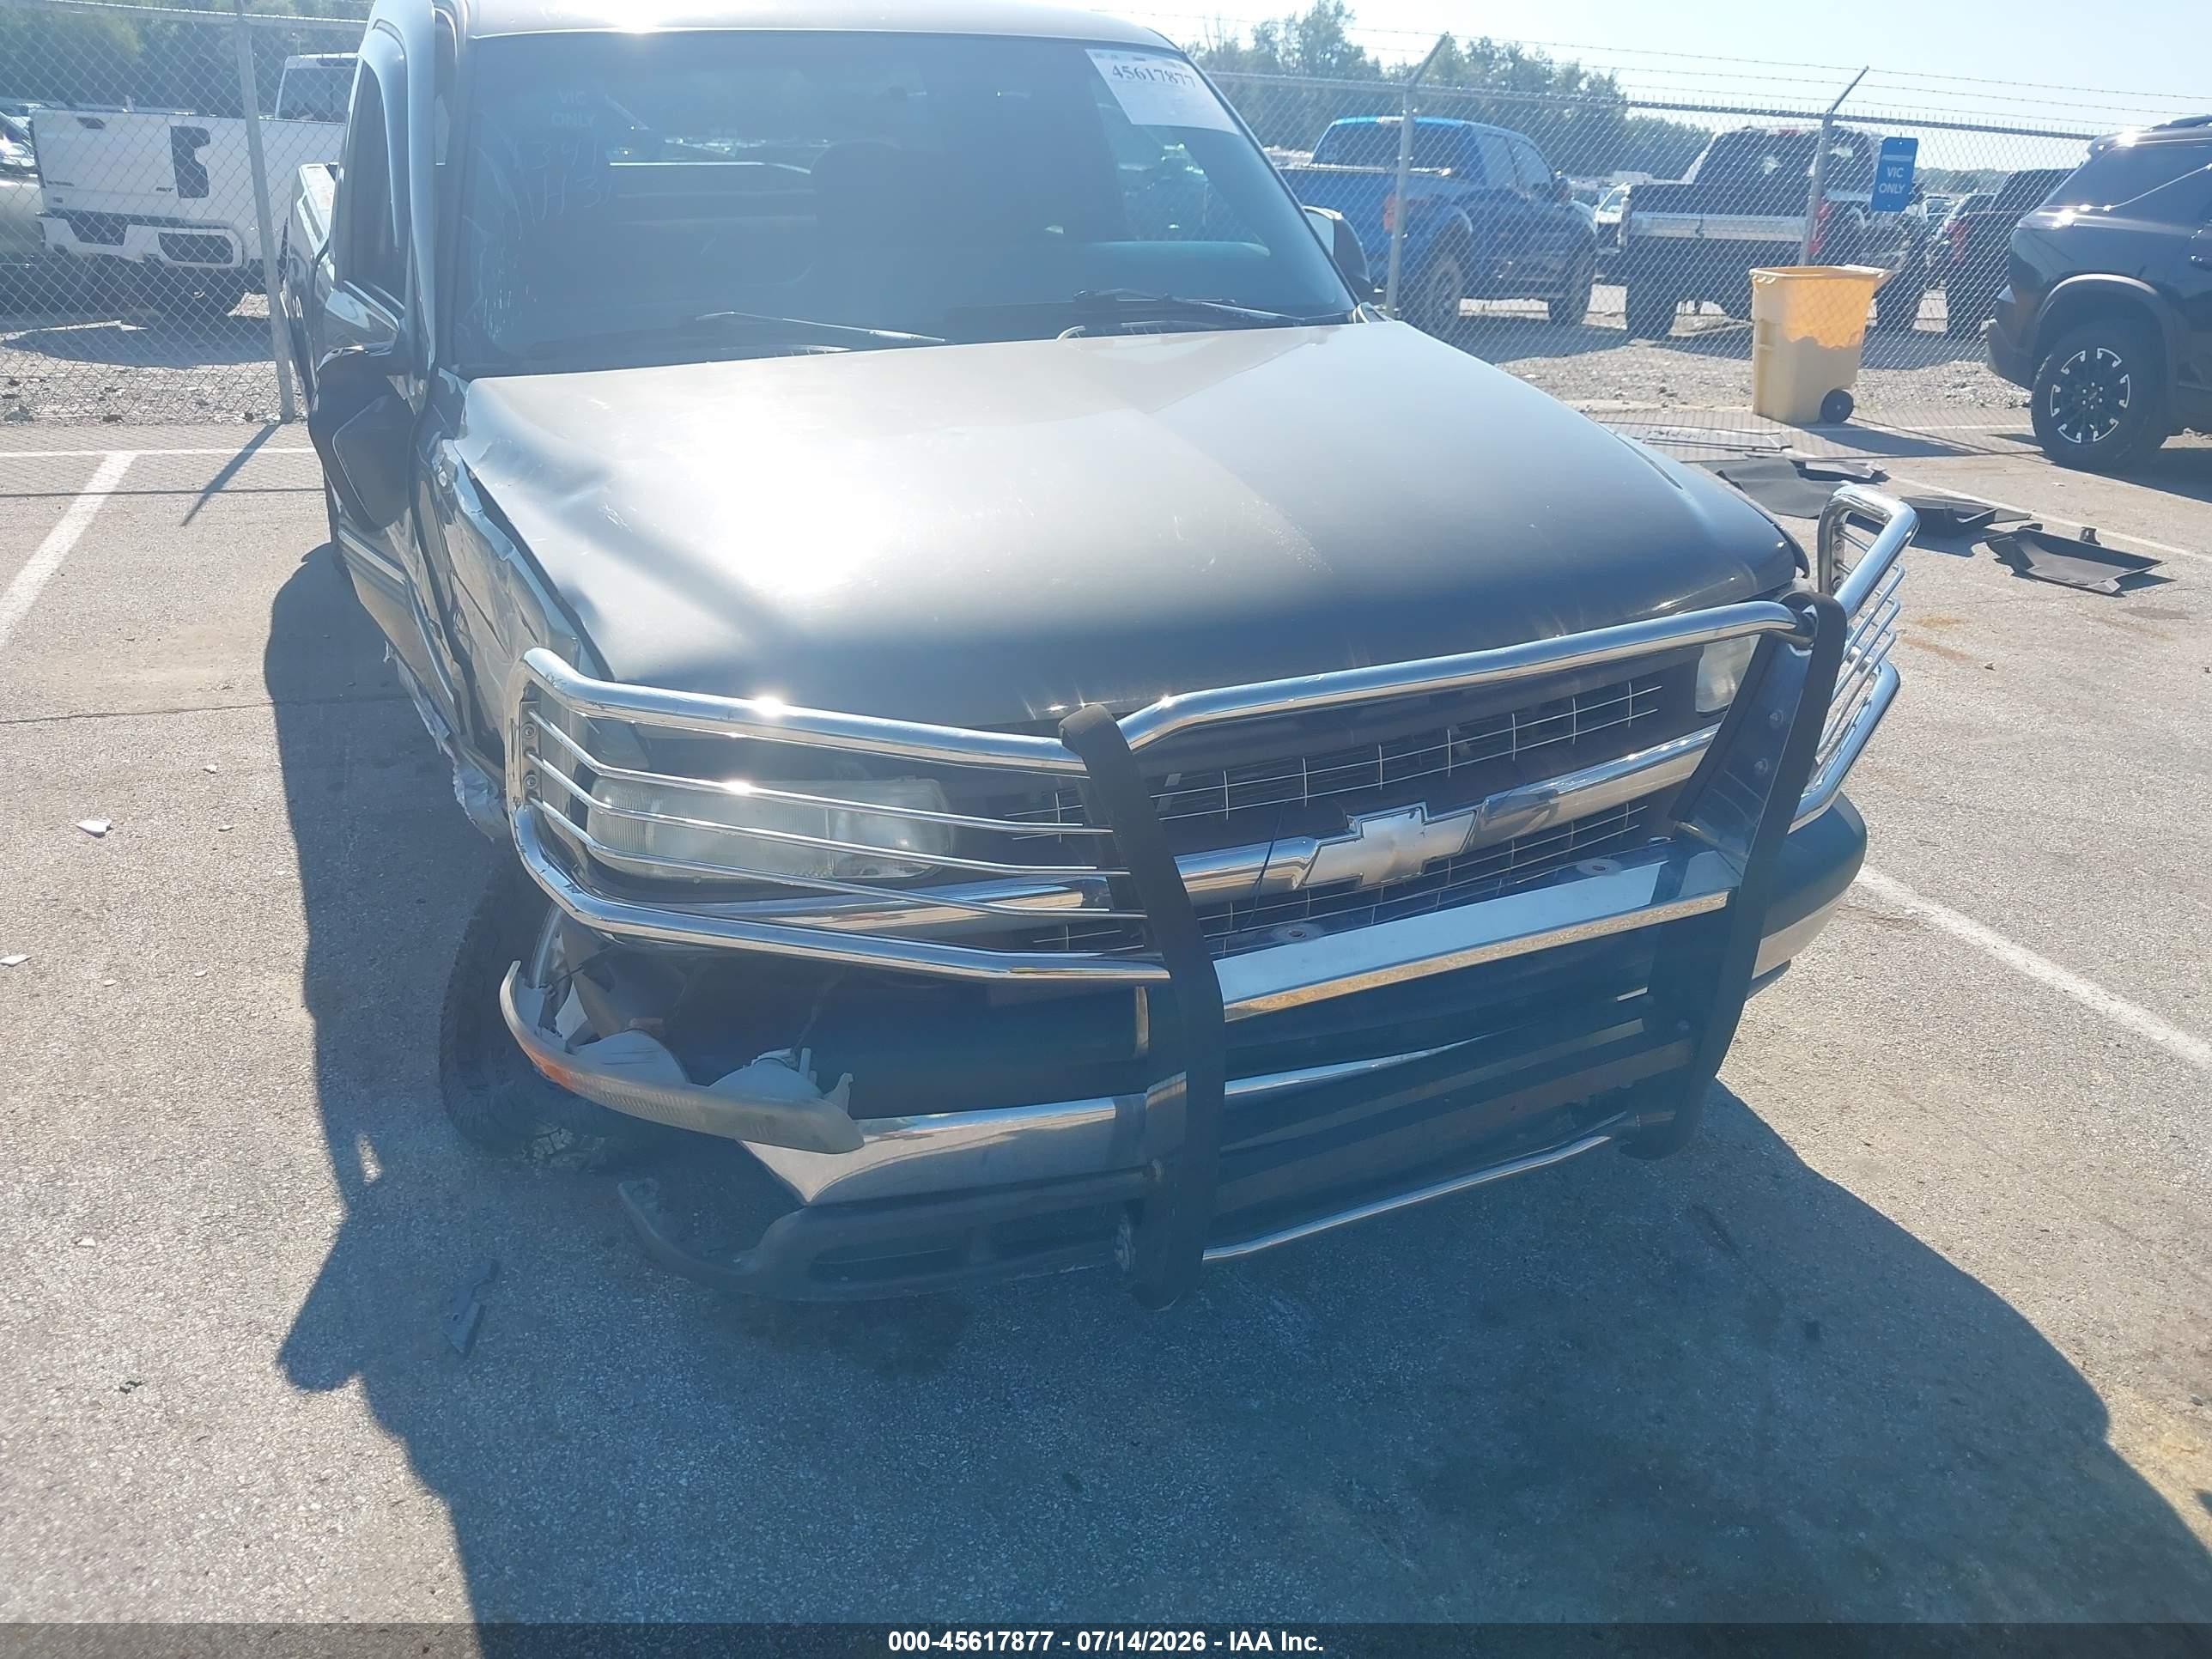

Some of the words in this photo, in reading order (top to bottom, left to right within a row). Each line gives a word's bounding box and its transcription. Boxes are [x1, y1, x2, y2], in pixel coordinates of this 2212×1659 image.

[1112, 64, 1196, 88] 45617877
[550, 111, 597, 128] ONLY
[1887, 166, 1905, 179] VIC
[1878, 182, 1906, 194] ONLY
